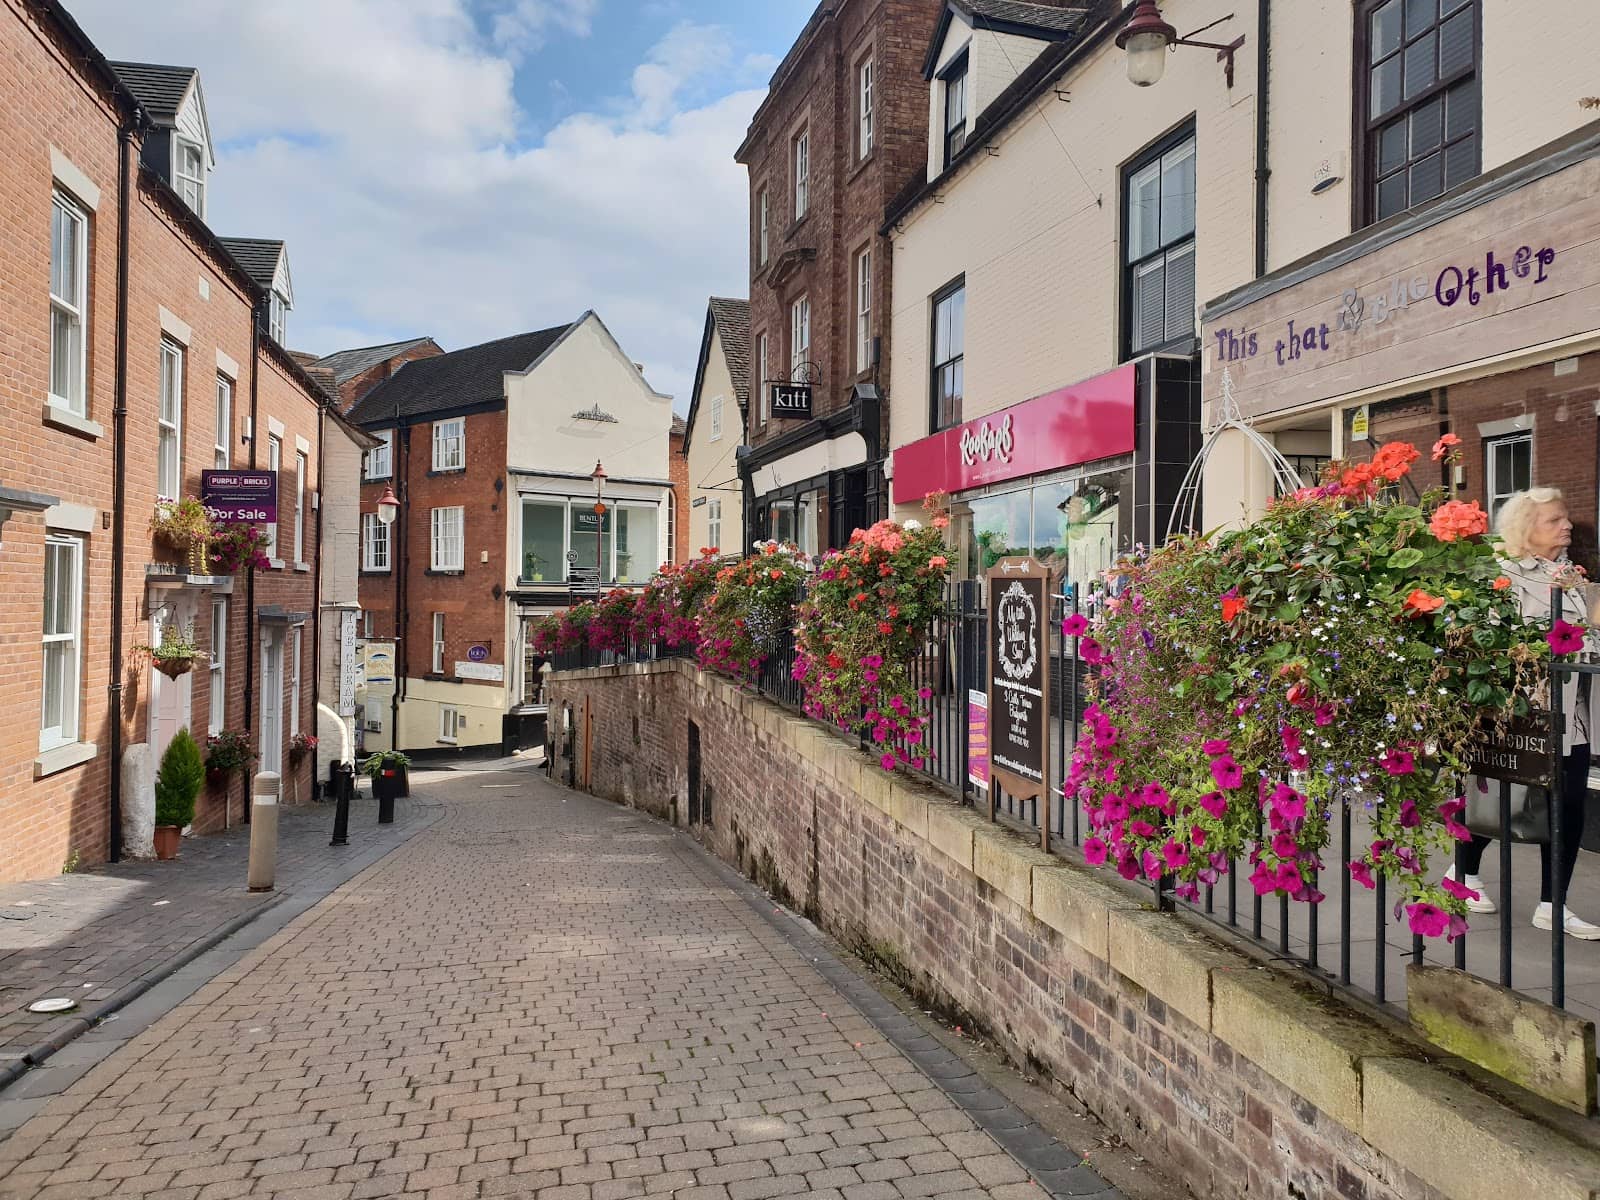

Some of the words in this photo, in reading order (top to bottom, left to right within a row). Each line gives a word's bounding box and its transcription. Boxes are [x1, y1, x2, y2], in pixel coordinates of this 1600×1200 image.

[1215, 328, 1257, 361] This
[1275, 320, 1329, 366] that
[1434, 246, 1555, 307] Other
[211, 477, 238, 485] PURPLE
[243, 478, 268, 486] BRICKS
[237, 508, 267, 520] Sale
[343, 613, 354, 647] ICE
[1486, 729, 1546, 755] TODIST
[1470, 748, 1518, 770] HURCH
